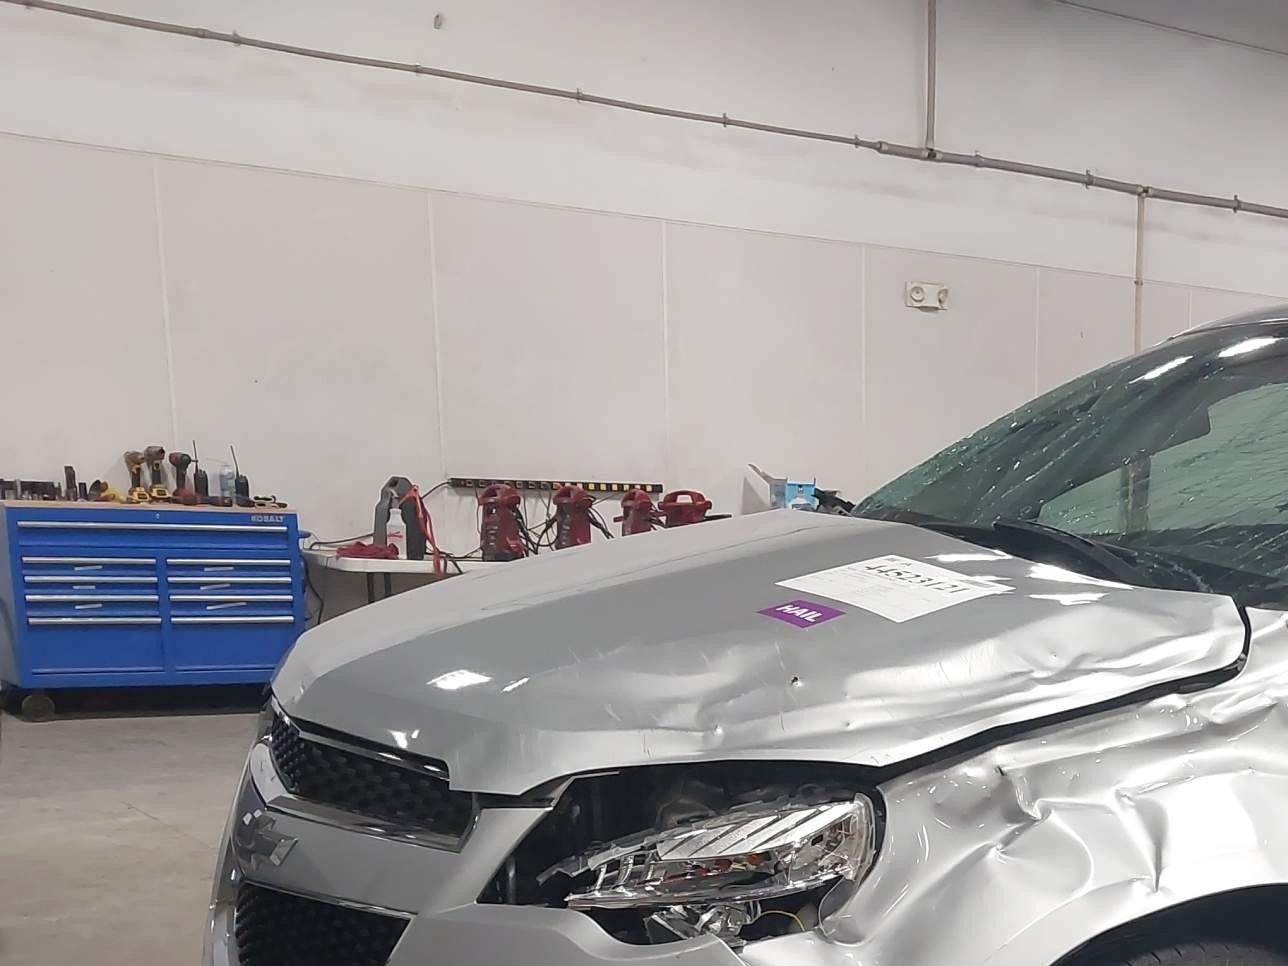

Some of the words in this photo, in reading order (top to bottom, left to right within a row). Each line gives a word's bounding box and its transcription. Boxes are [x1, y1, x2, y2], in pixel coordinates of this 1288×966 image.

[250, 515, 284, 523] KOBALT
[865, 564, 969, 594] 44523121
[776, 603, 824, 623] HAIL
